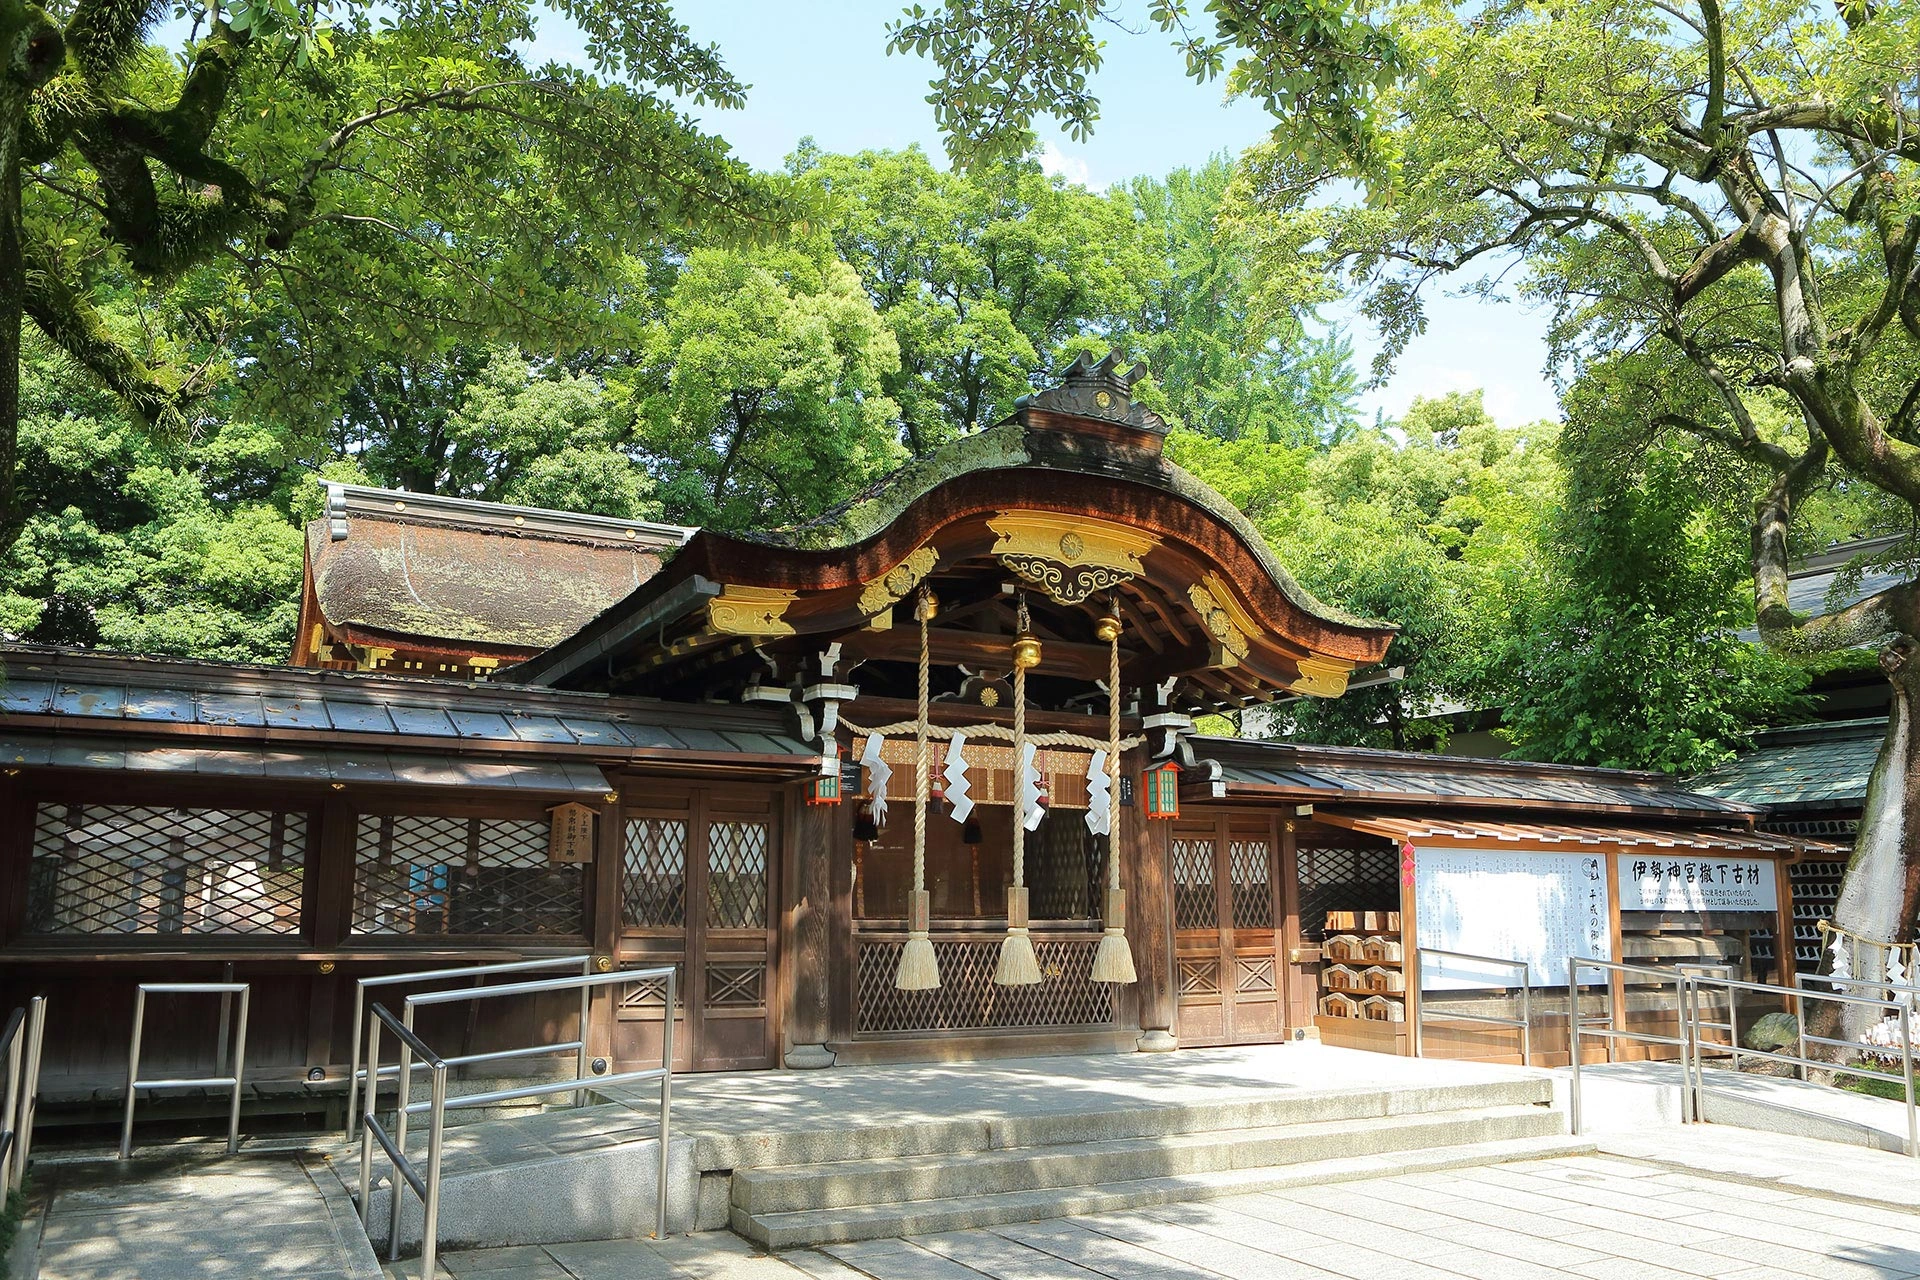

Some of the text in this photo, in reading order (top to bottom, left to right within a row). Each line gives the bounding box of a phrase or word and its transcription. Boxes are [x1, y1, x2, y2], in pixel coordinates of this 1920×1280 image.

[1632, 860, 1760, 885] 伊勢神宮撤下古材
